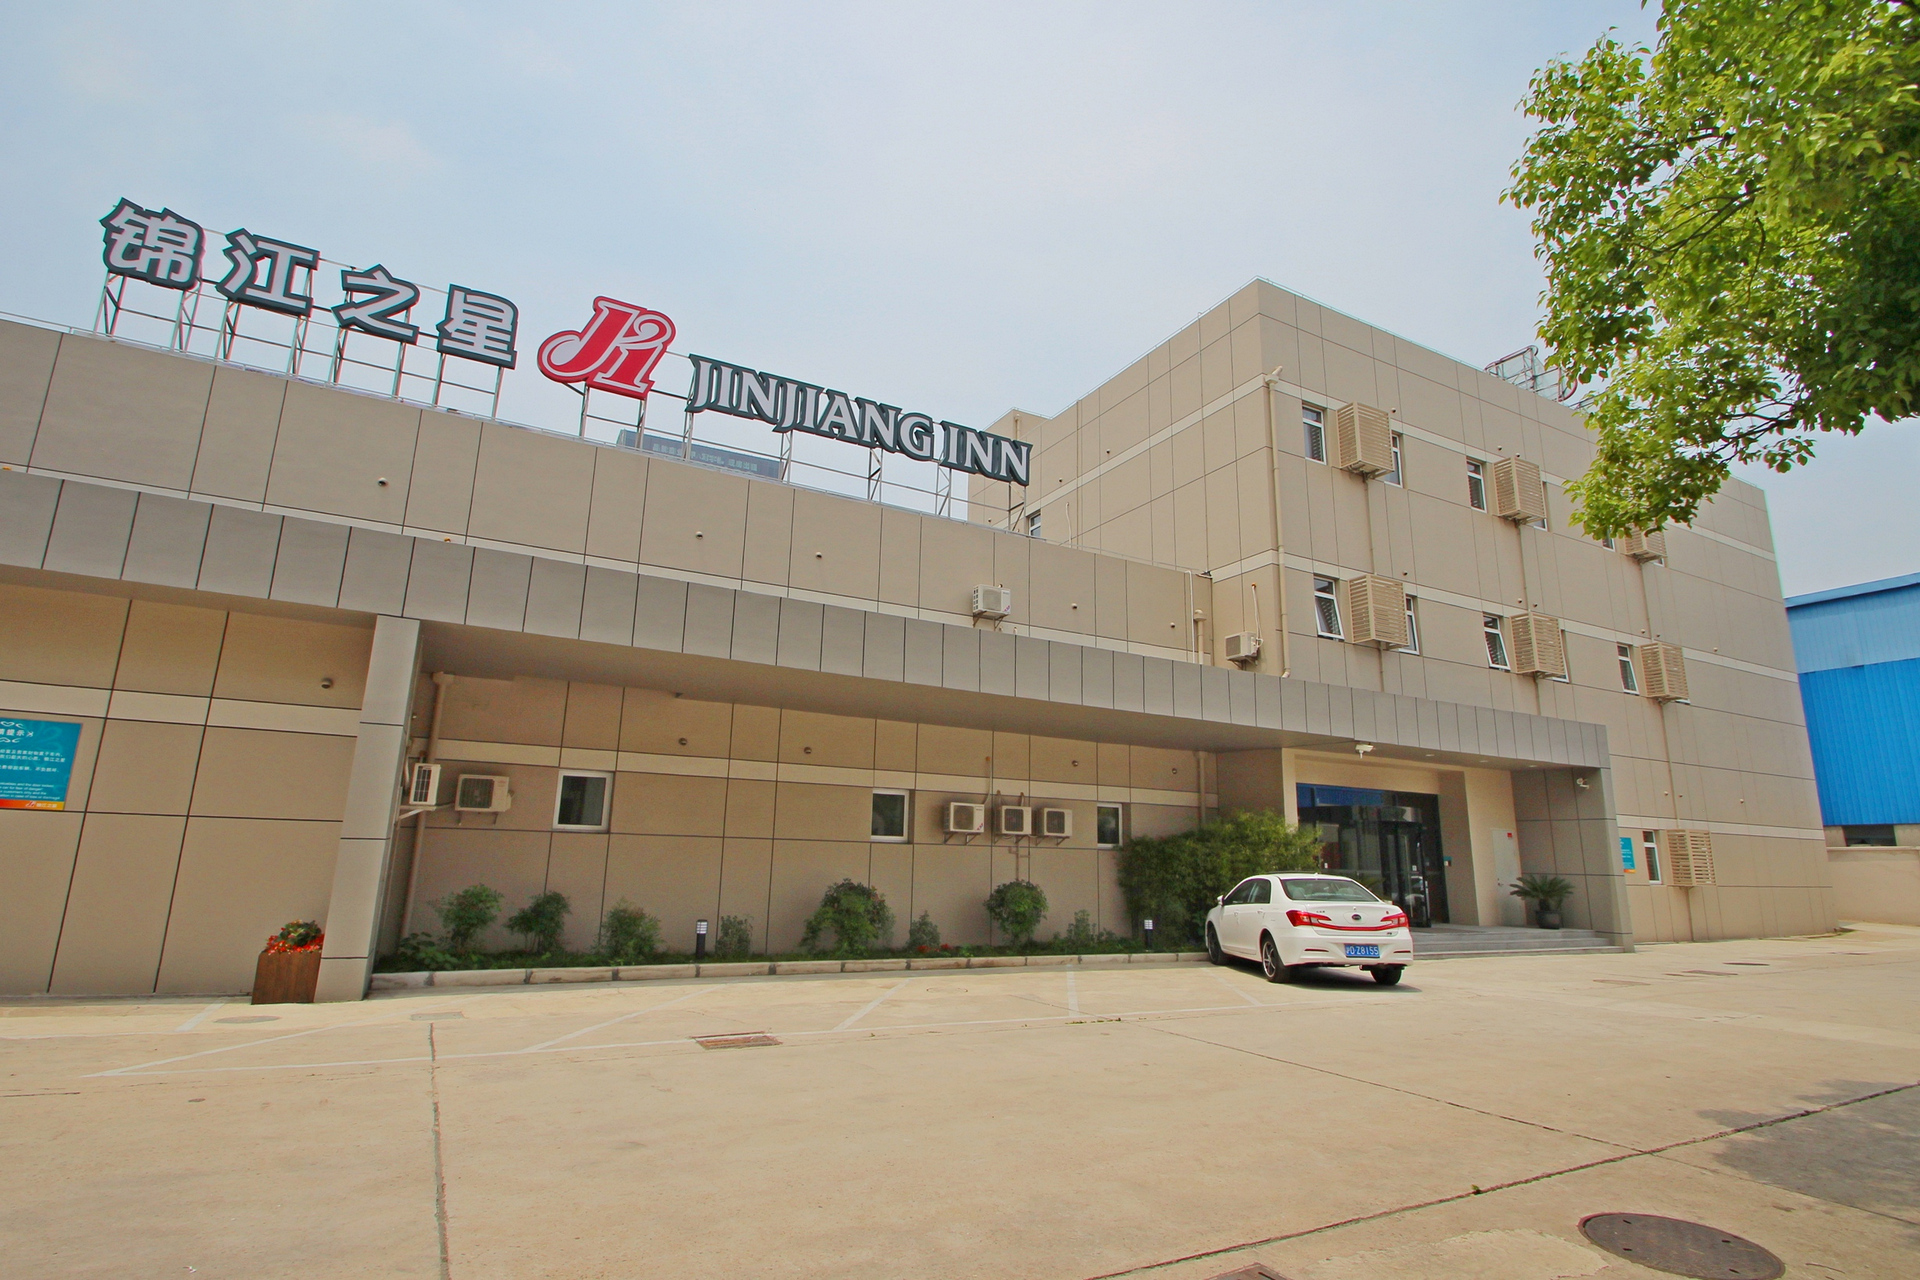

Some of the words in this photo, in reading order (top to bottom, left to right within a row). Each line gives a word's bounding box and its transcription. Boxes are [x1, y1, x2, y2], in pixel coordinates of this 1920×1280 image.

[100, 198, 519, 369] 锦江之星
[685, 354, 937, 462] JINJIANG
[939, 421, 1033, 486] INN
